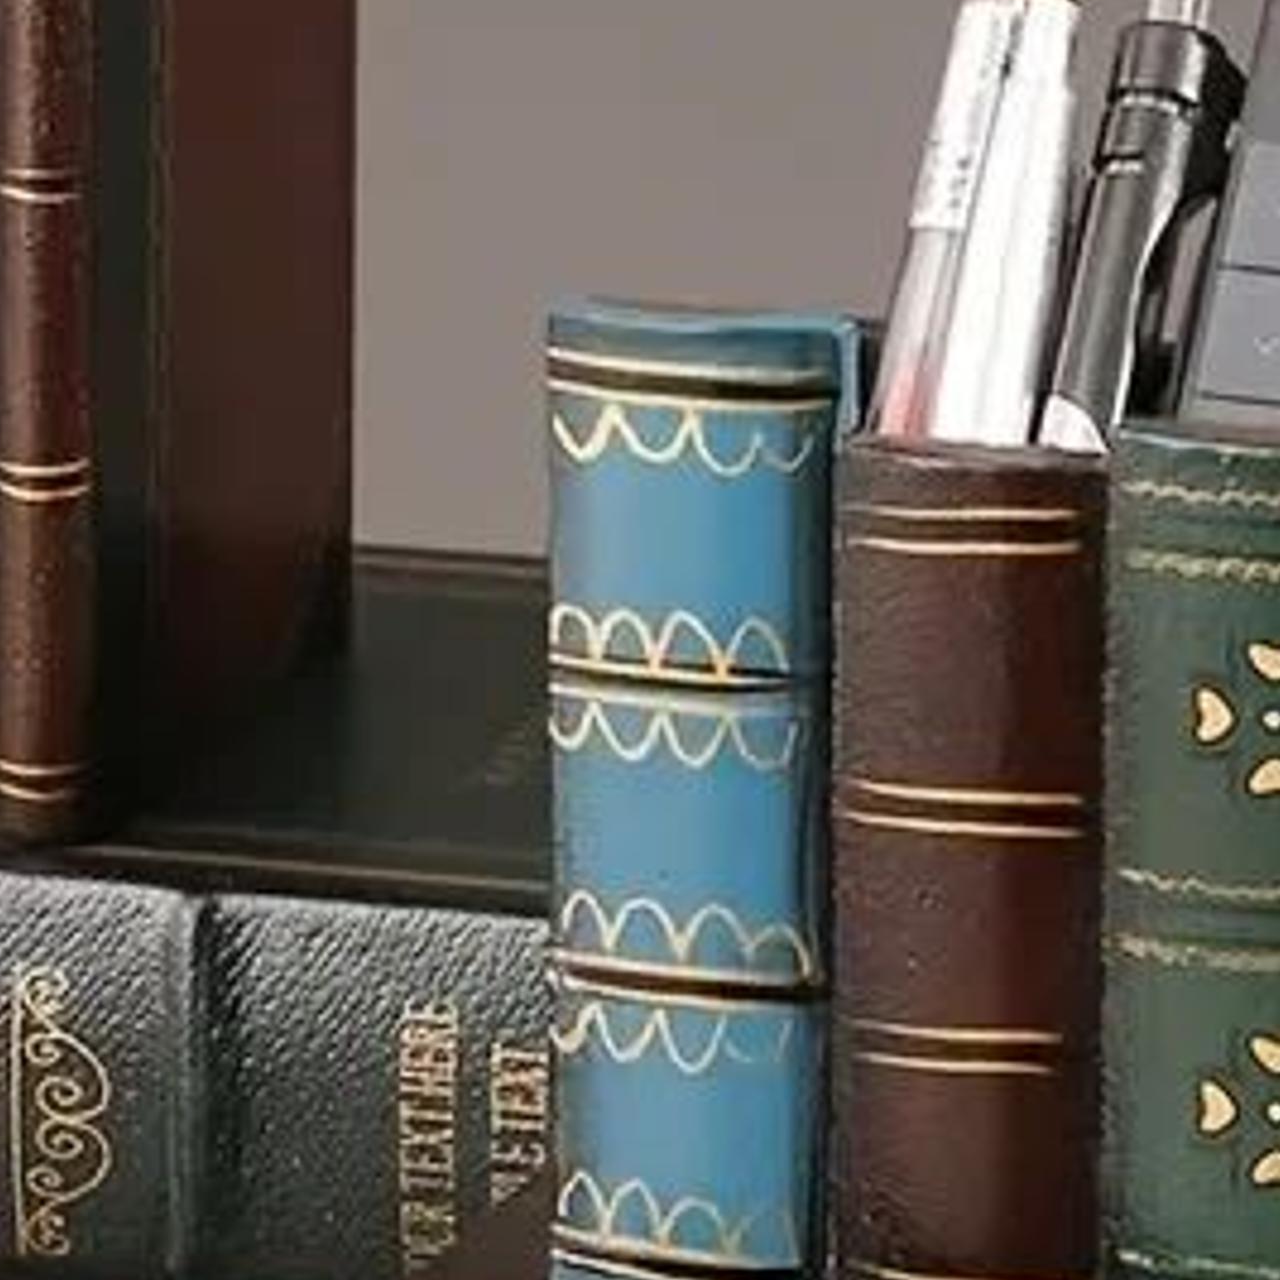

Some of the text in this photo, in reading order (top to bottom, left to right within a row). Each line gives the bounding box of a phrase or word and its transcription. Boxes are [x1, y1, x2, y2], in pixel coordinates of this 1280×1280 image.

[399, 997, 458, 1100] HERE
[490, 1040, 549, 1133] TEXT
[399, 1101, 454, 1194] TEXT
